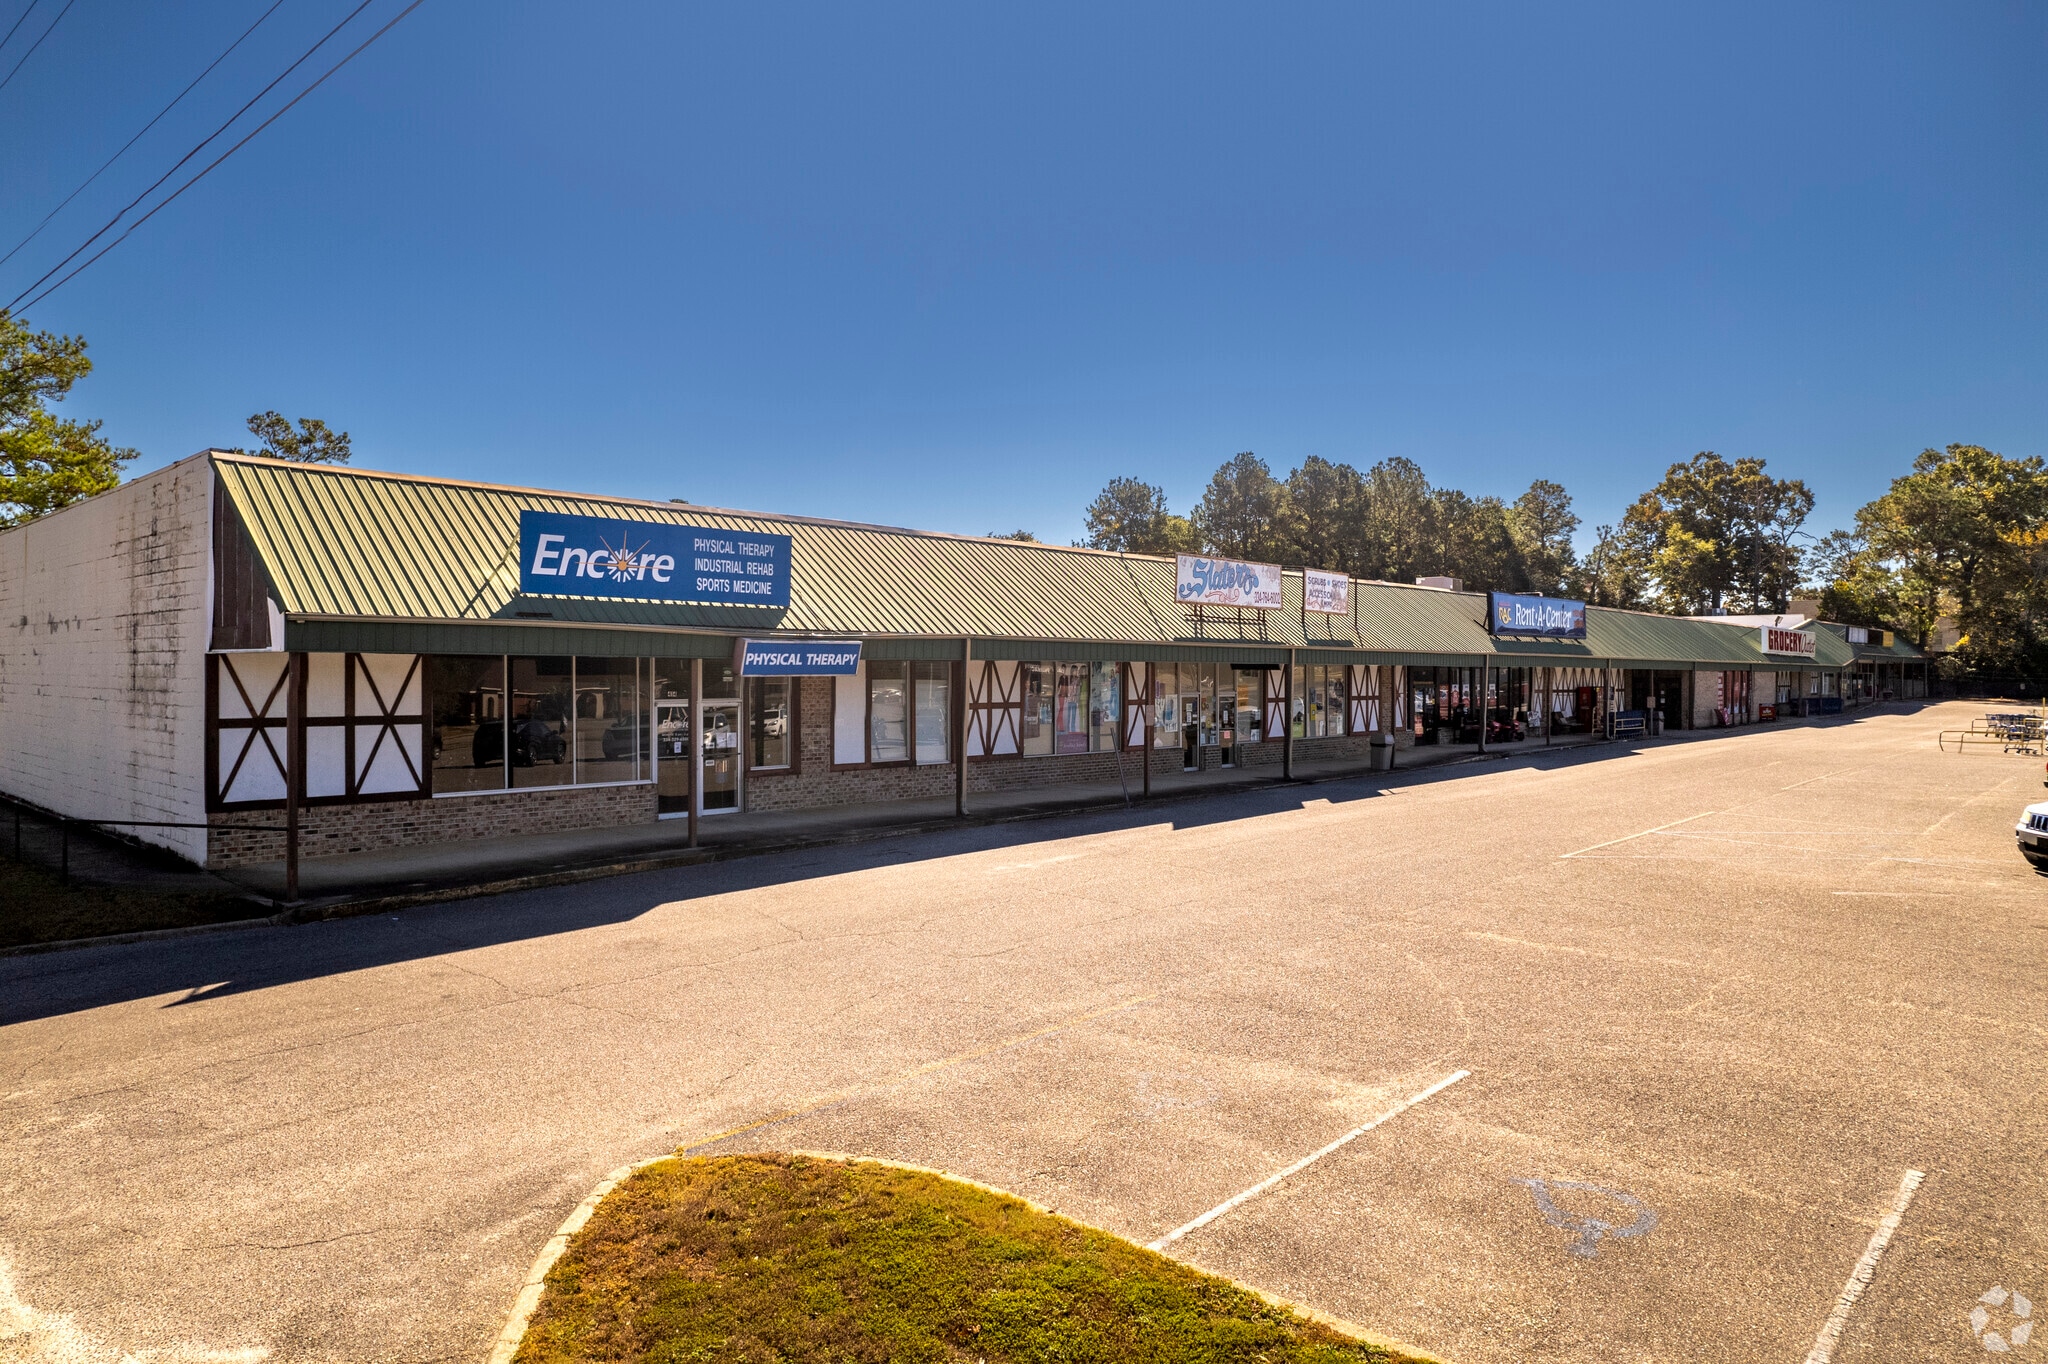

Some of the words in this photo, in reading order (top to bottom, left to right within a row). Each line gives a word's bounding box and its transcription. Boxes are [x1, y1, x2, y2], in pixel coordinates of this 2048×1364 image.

[694, 538, 735, 555] PHYSICAL
[738, 542, 775, 558] THERAPY
[531, 533, 675, 583] Encore
[694, 557, 744, 574] INDUSTRIAL
[746, 561, 774, 576] REHAB
[696, 577, 730, 593] SPORTS
[733, 580, 772, 595] MEDICINE
[1768, 629, 1802, 652] GROCERY
[745, 653, 803, 666] PHYSICAL
[806, 653, 858, 666] THERAPY
